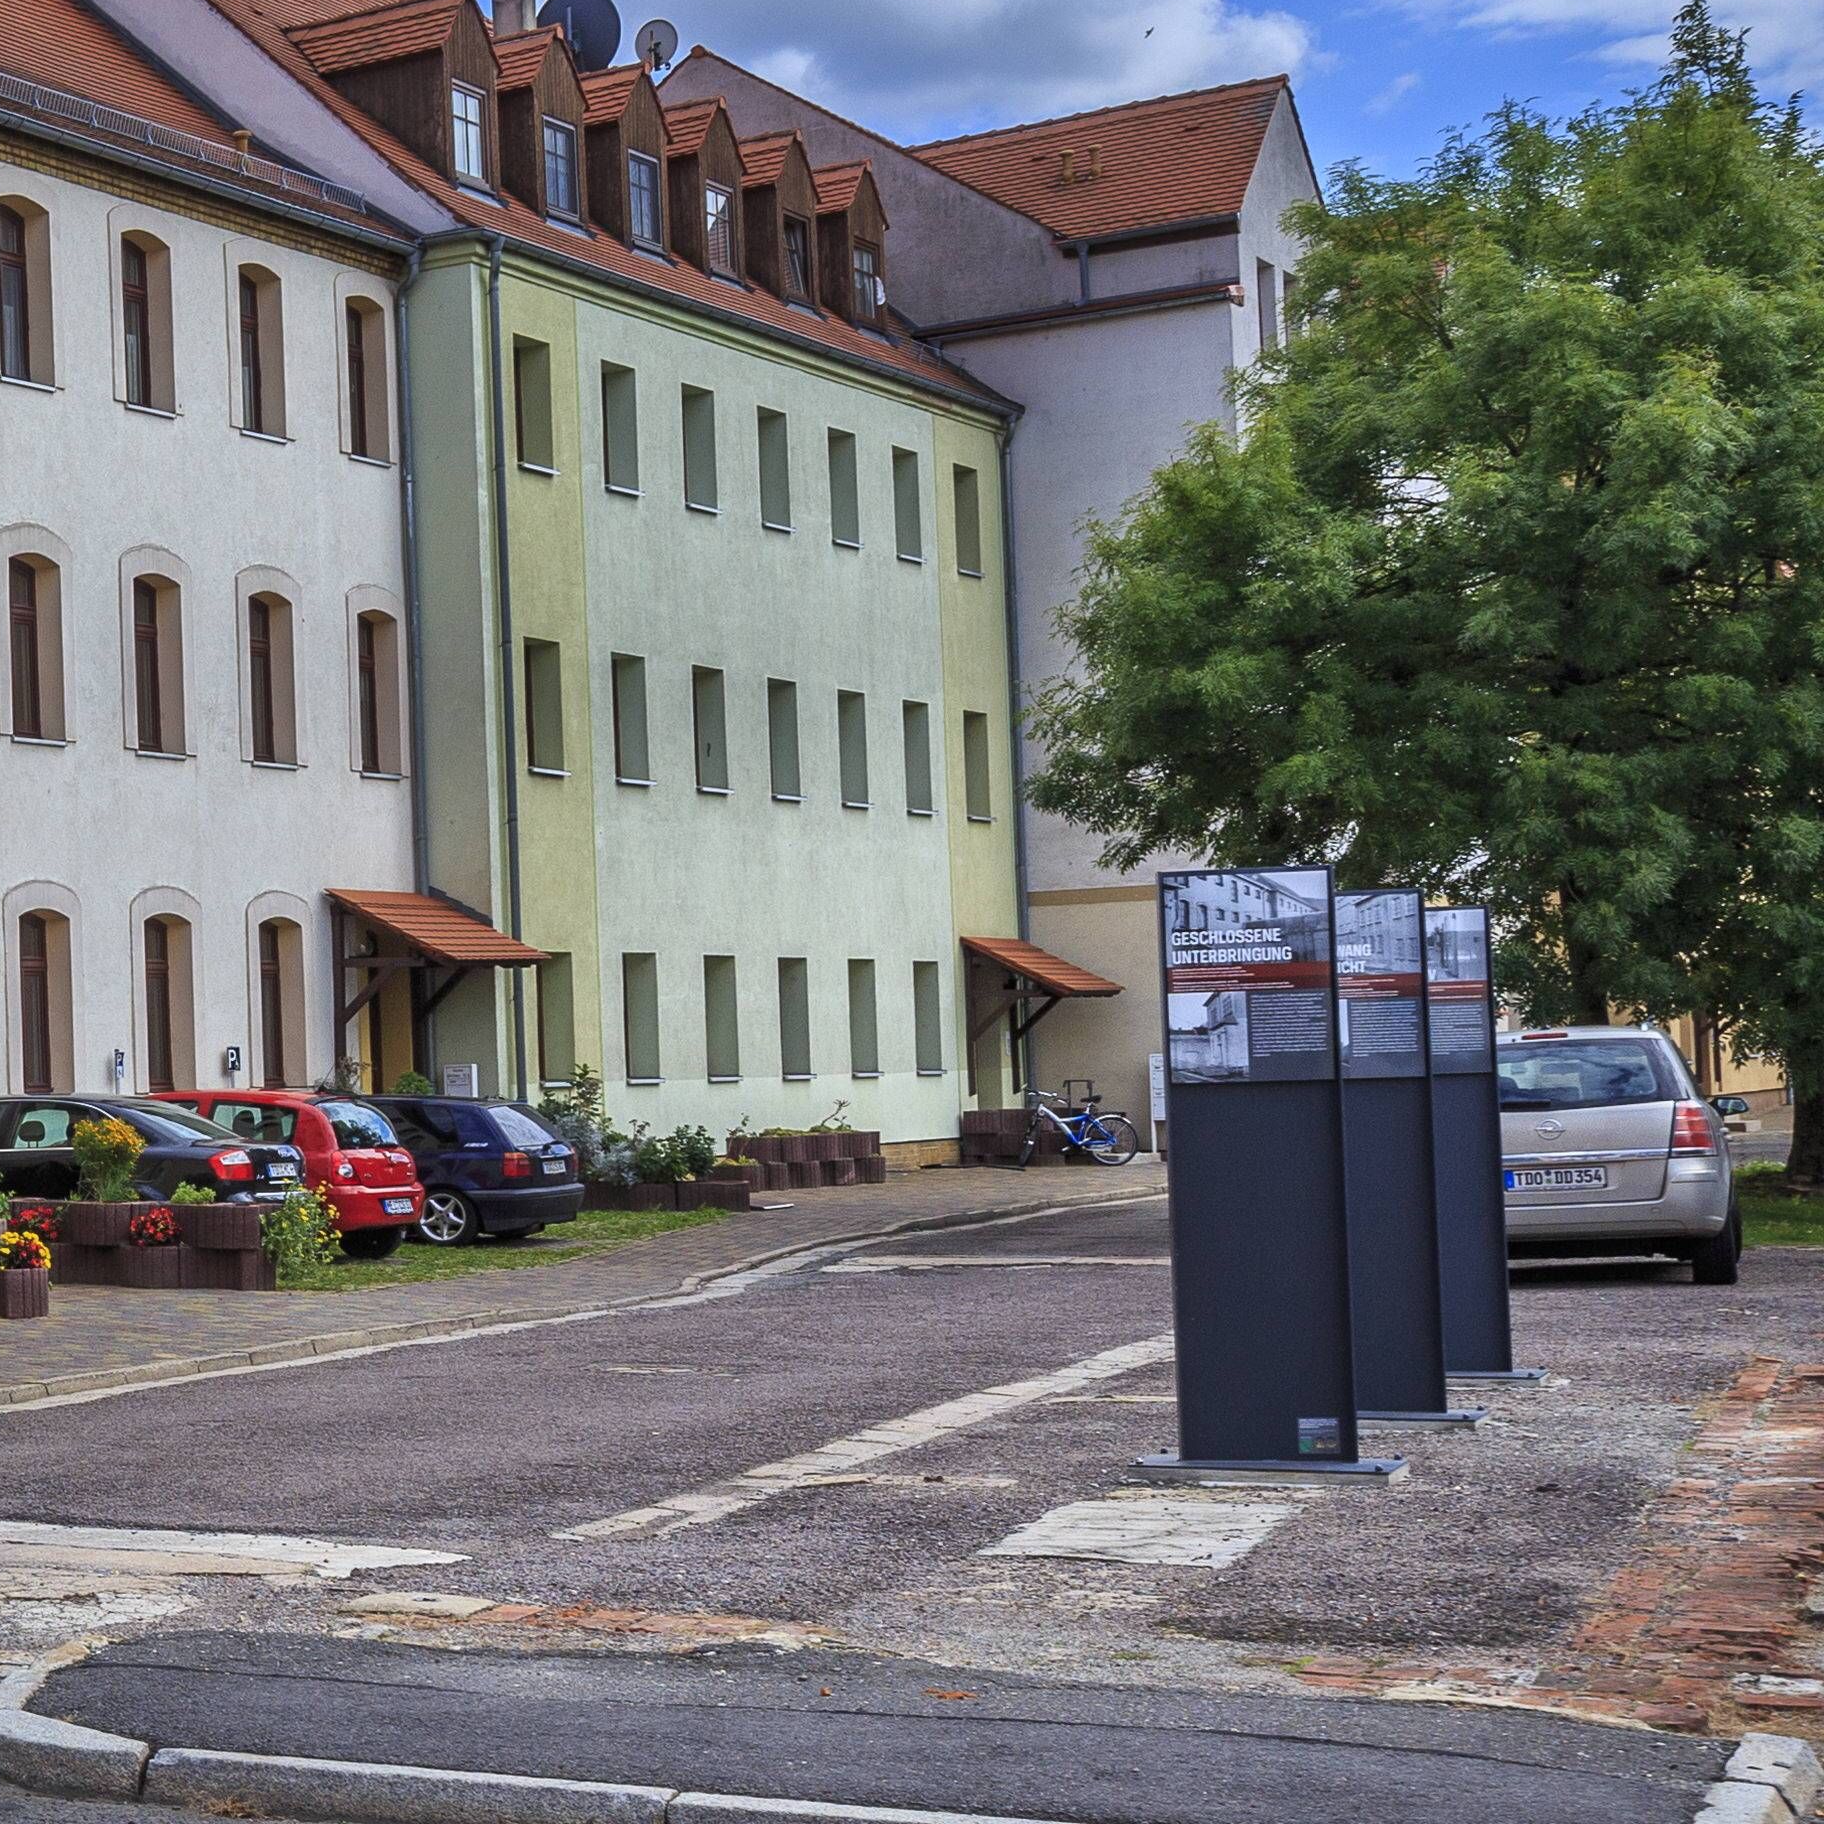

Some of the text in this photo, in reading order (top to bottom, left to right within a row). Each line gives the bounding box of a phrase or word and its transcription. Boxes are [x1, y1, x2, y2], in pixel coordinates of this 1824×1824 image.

[1171, 927, 1282, 946] GESCHLOSSENE
[1172, 946, 1293, 965] UNTERBRINGUNG
[1515, 1171, 1543, 1186] TDO
